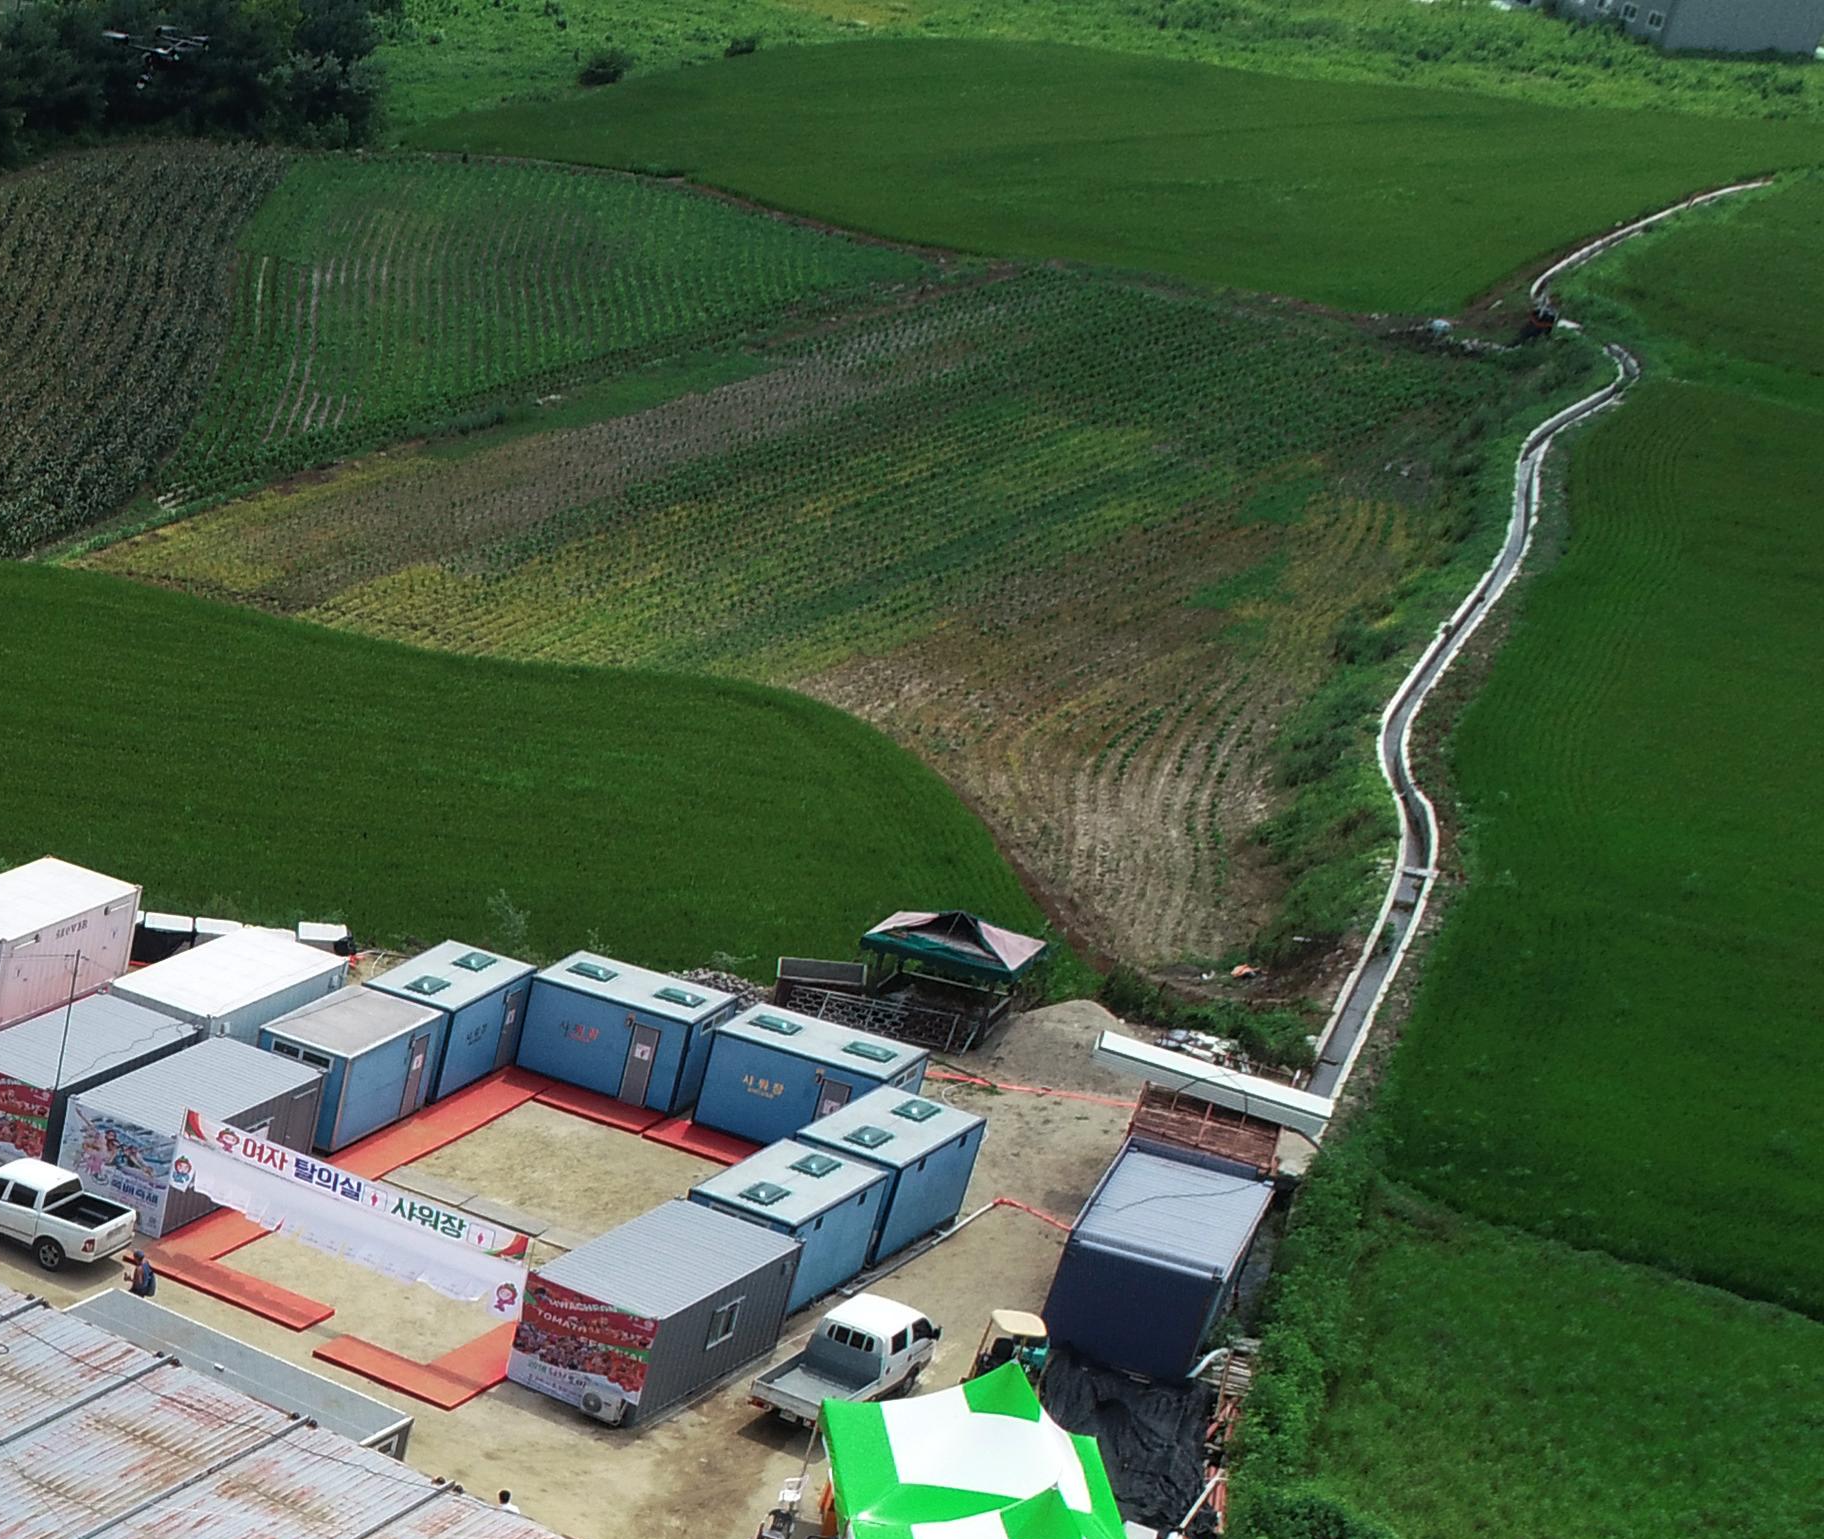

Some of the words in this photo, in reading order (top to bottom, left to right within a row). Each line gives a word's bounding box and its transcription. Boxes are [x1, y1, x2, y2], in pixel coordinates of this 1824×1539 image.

[241, 1139, 290, 1172] 여자
[293, 1156, 364, 1203] 탈의실
[390, 1196, 468, 1240] 샤워장
